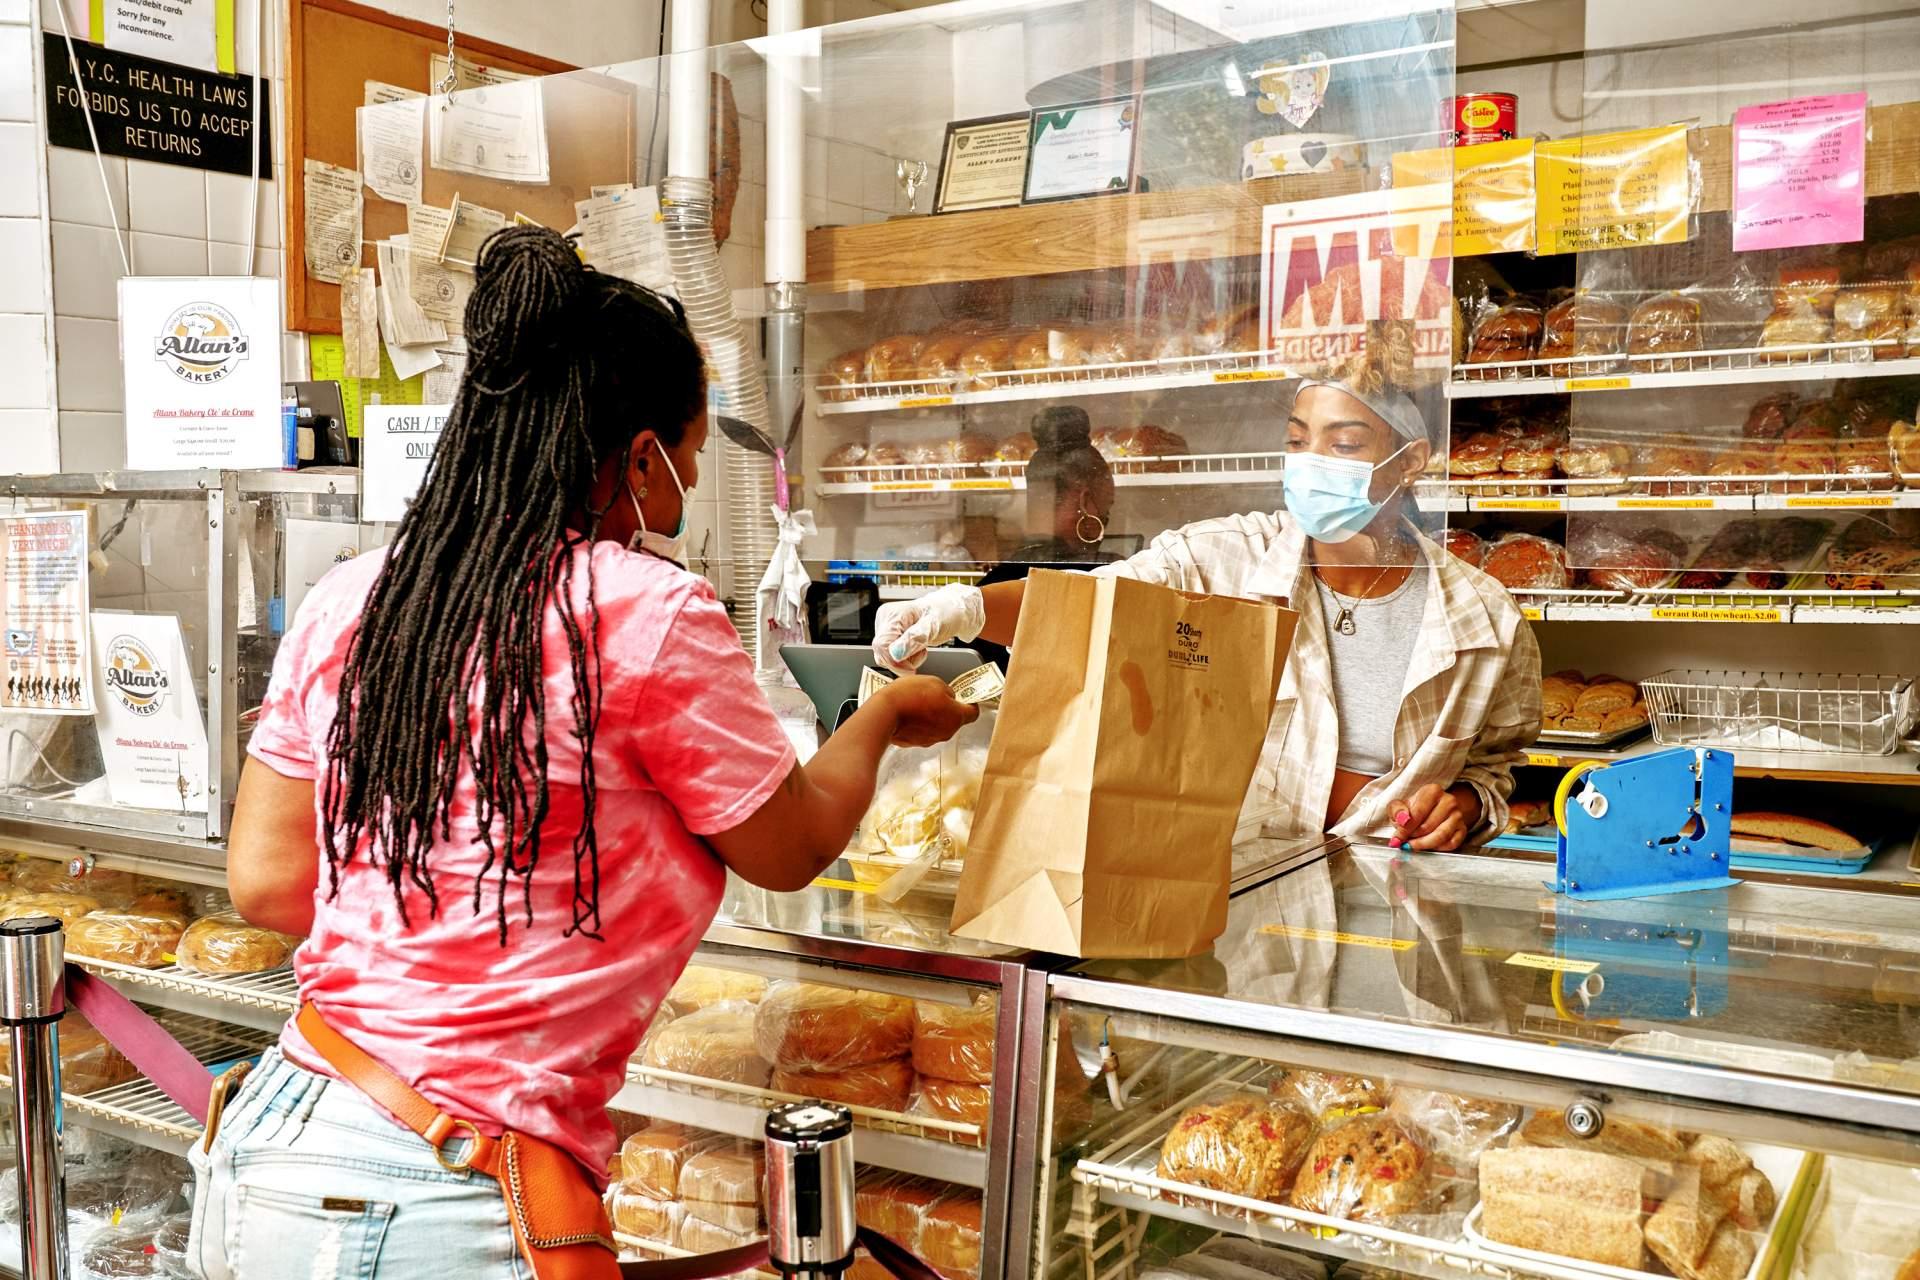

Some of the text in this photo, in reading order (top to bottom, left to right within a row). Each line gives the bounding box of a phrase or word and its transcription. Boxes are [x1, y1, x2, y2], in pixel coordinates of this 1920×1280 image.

[117, 7, 166, 27] Sorry for any
[163, 5, 183, 16] cards
[117, 22, 175, 41] inconvenience.
[128, 68, 194, 98] HEALTH
[202, 83, 248, 108] LAWS
[56, 85, 253, 137] FORBIDS US TO ACCEP
[125, 126, 202, 156] RETURNS
[1455, 229, 1462, 237] &
[156, 336, 248, 356] Allan's
[176, 365, 228, 382] BAKERY
[387, 416, 420, 432] CASH
[12, 539, 35, 551] VERY
[1656, 609, 1690, 618] Currant
[1691, 609, 1708, 618] Roll
[1176, 621, 1191, 636] 20
[1178, 639, 1199, 649] DURO
[1192, 654, 1209, 664] LIFE
[106, 667, 168, 688] Allan's
[122, 697, 160, 714] BAKERY
